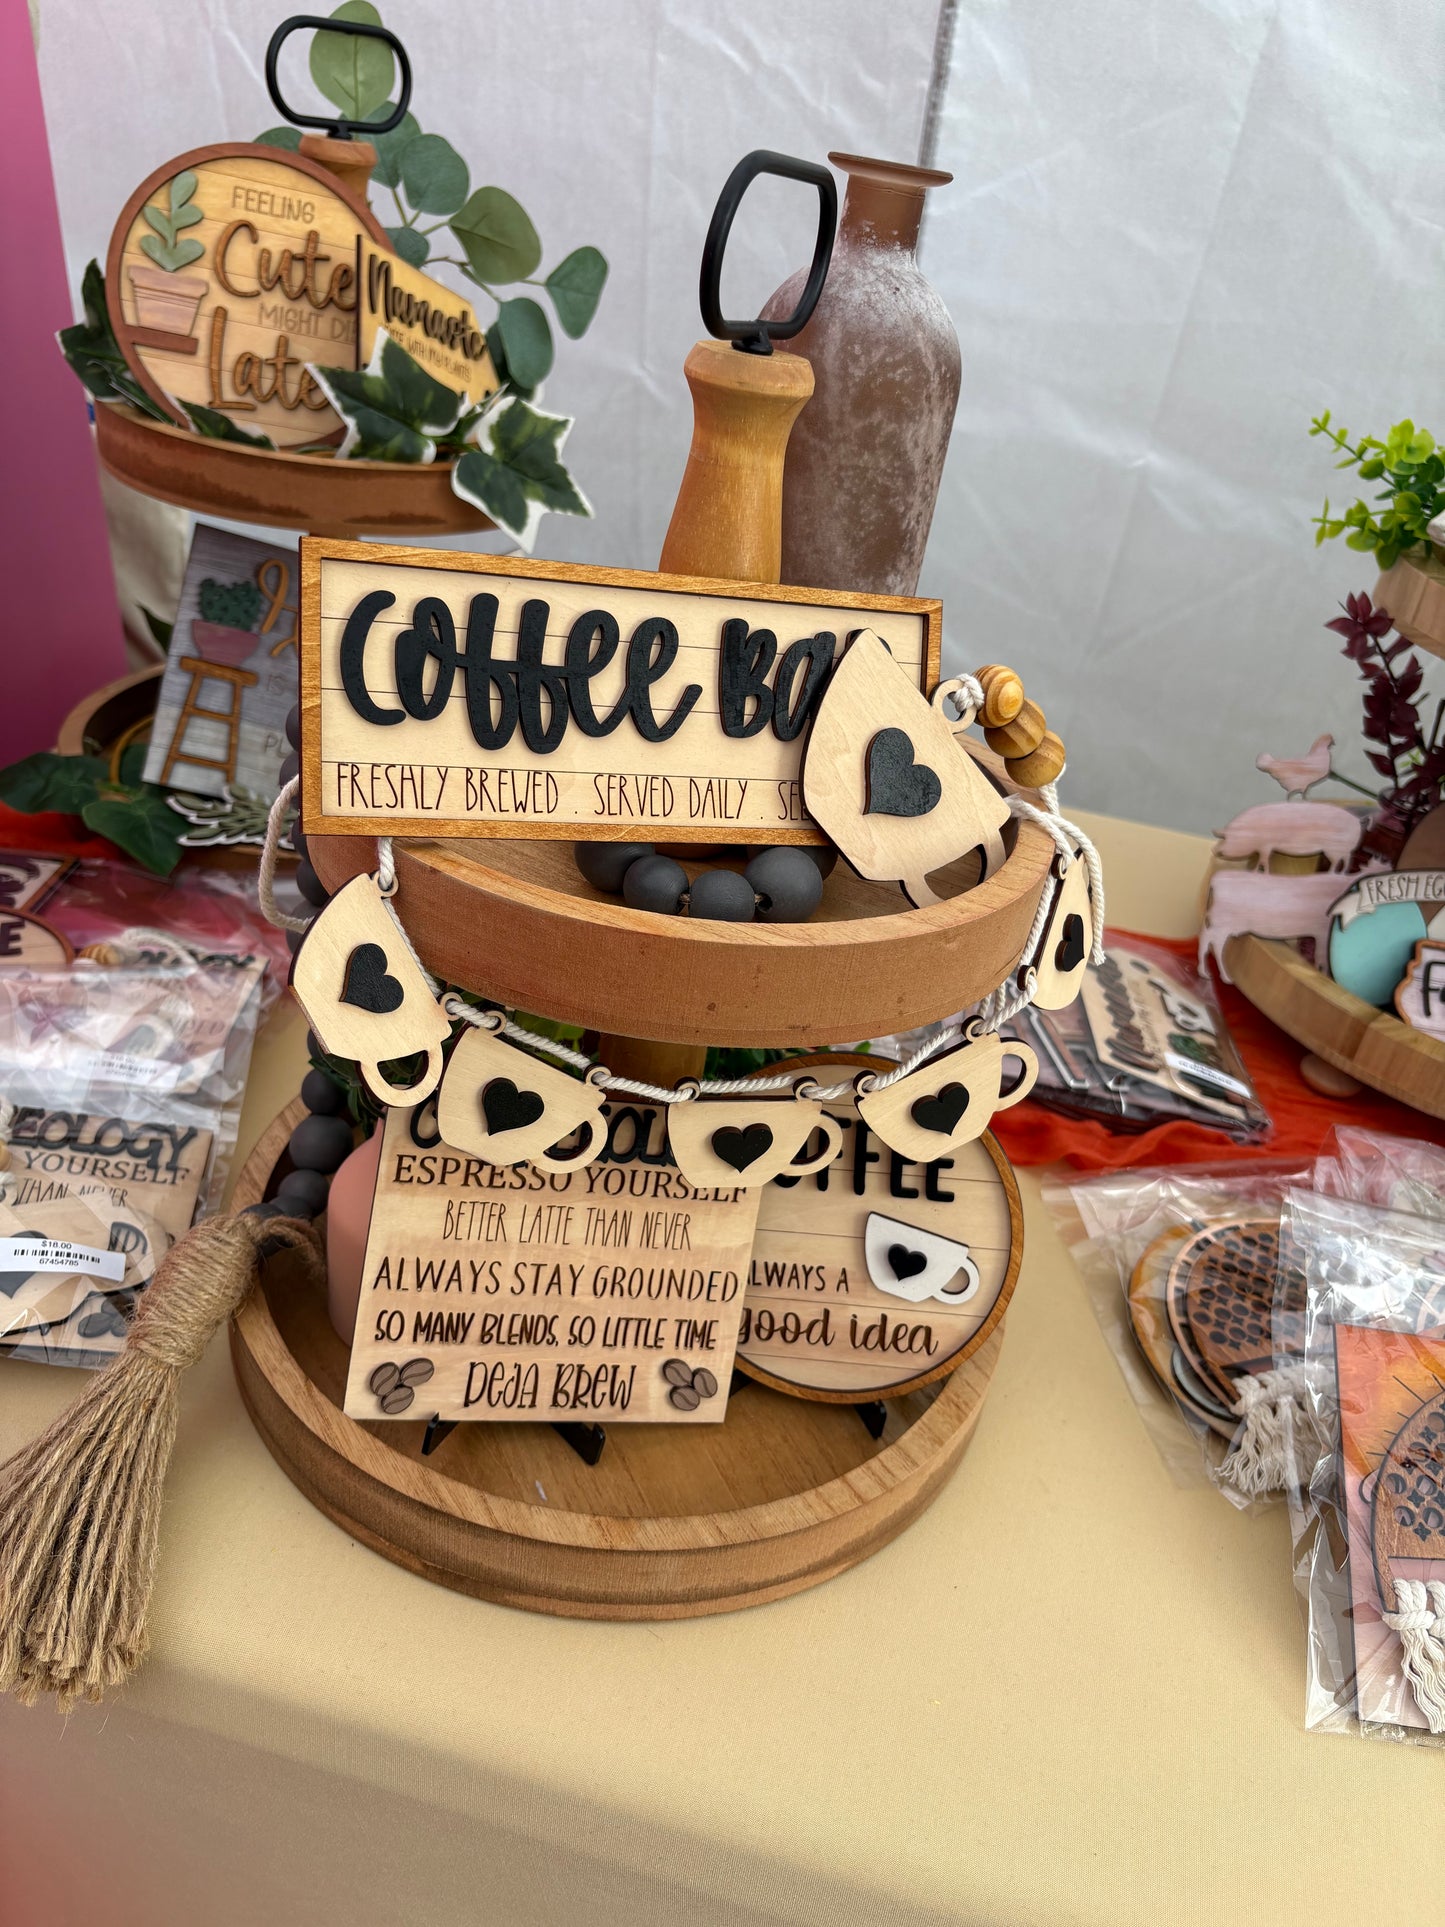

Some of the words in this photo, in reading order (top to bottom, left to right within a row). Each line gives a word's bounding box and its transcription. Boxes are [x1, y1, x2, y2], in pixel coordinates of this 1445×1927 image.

[231, 186, 315, 224] FEELING
[214, 219, 357, 311] Cute
[258, 302, 322, 336] MIGHT
[208, 306, 342, 411] Late
[719, 618, 892, 742] Ba
[337, 763, 449, 811] FRESHLY
[466, 767, 559, 814] BREWED
[593, 774, 675, 818] SERVED
[689, 778, 748, 820] DAILY
[777, 781, 811, 821] SE
[1367, 872, 1420, 905] FRESH
[8, 1105, 198, 1172] EOLOGY
[24, 1150, 190, 1186] YOURSELF
[393, 1153, 573, 1193] ESPRESSO
[17, 1177, 70, 1206] THAN
[41, 1240, 72, 1250] $18.00
[443, 1199, 507, 1243] BETTER
[519, 1204, 575, 1246] LATTE
[584, 1207, 633, 1248] THAN
[639, 1210, 692, 1251] NEVER
[373, 1255, 503, 1295] ALWAYS
[510, 1262, 585, 1297] STAY
[592, 1265, 739, 1303] GROUNDED
[748, 1260, 826, 1292] LWAYS
[836, 1266, 850, 1294] A
[374, 1309, 406, 1342] SO
[412, 1310, 476, 1344] MANY
[480, 1312, 559, 1347] BLENDS,
[567, 1315, 596, 1346] SO
[602, 1316, 668, 1349] LITTLE
[674, 1318, 720, 1350] TIME
[850, 1312, 939, 1356] idea
